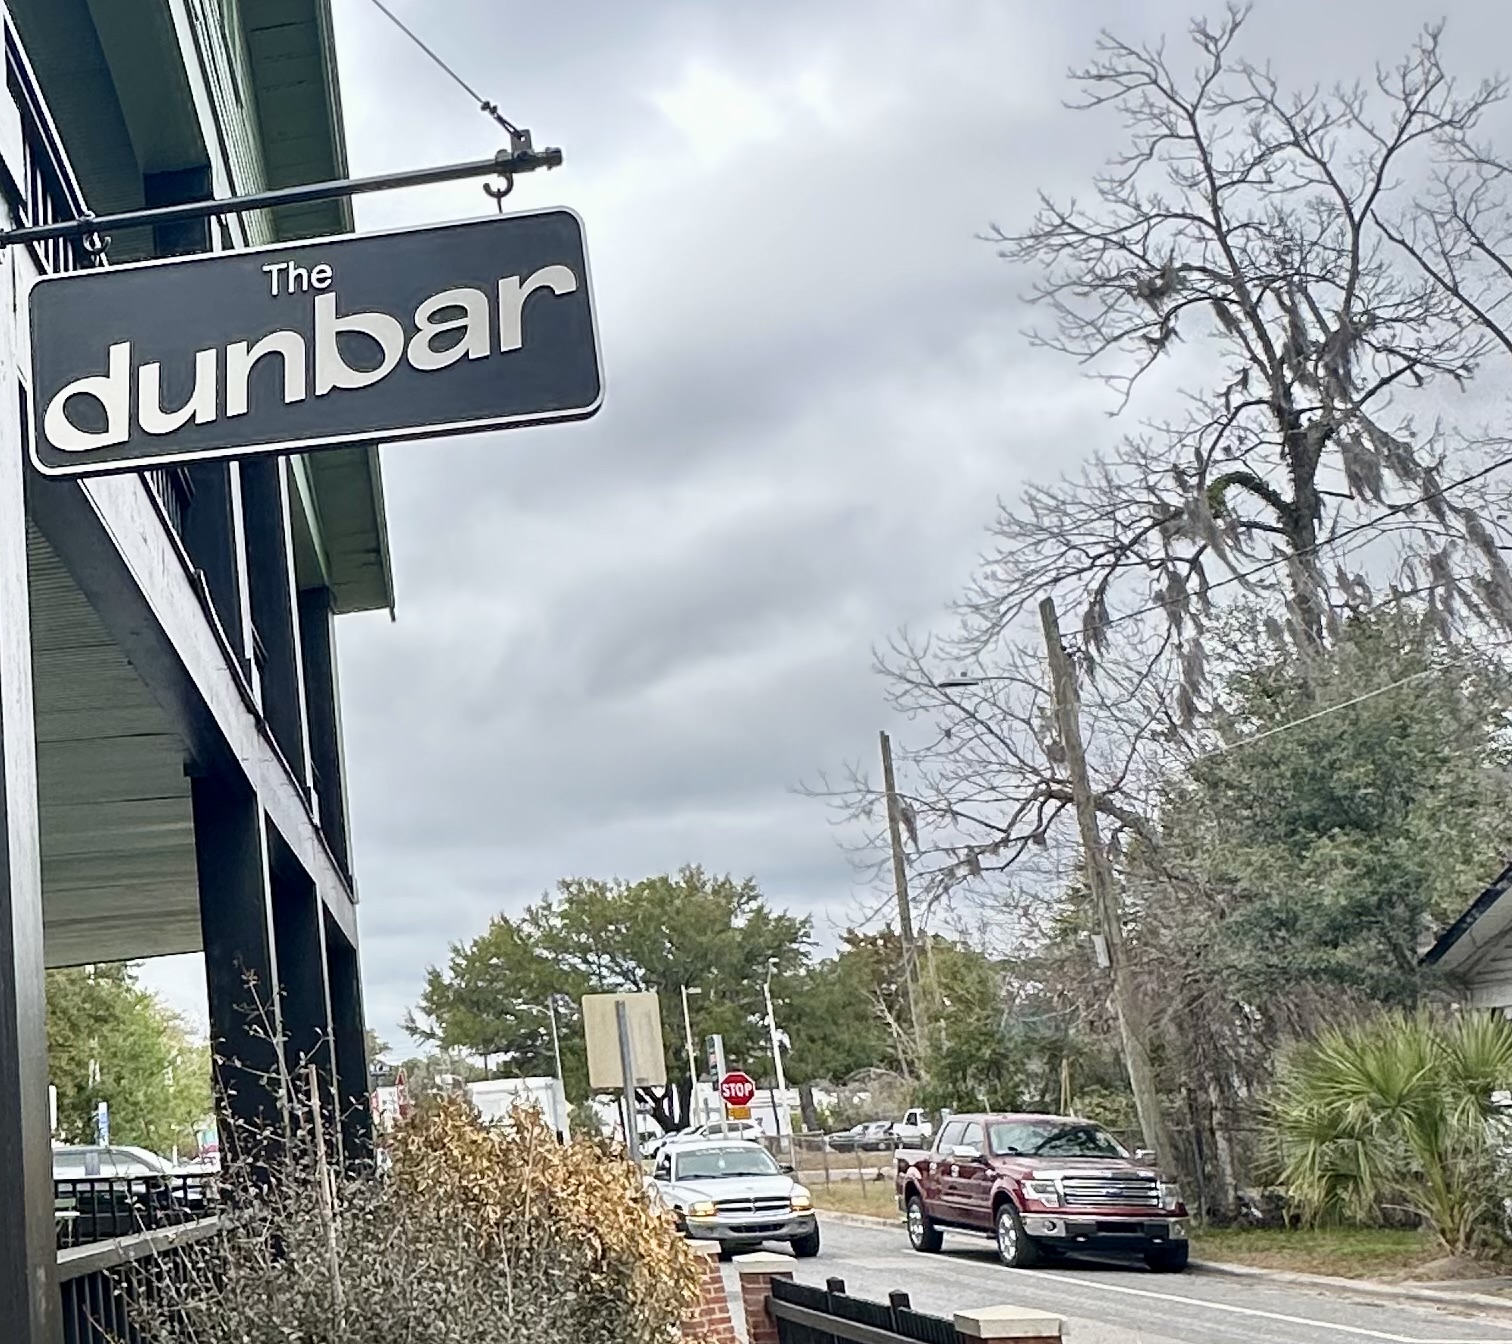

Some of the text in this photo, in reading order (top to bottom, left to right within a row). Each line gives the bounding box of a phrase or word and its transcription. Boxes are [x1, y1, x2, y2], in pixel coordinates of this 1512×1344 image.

[263, 260, 332, 296] The
[44, 264, 577, 452] dunbar
[722, 1082, 753, 1097] STOP
